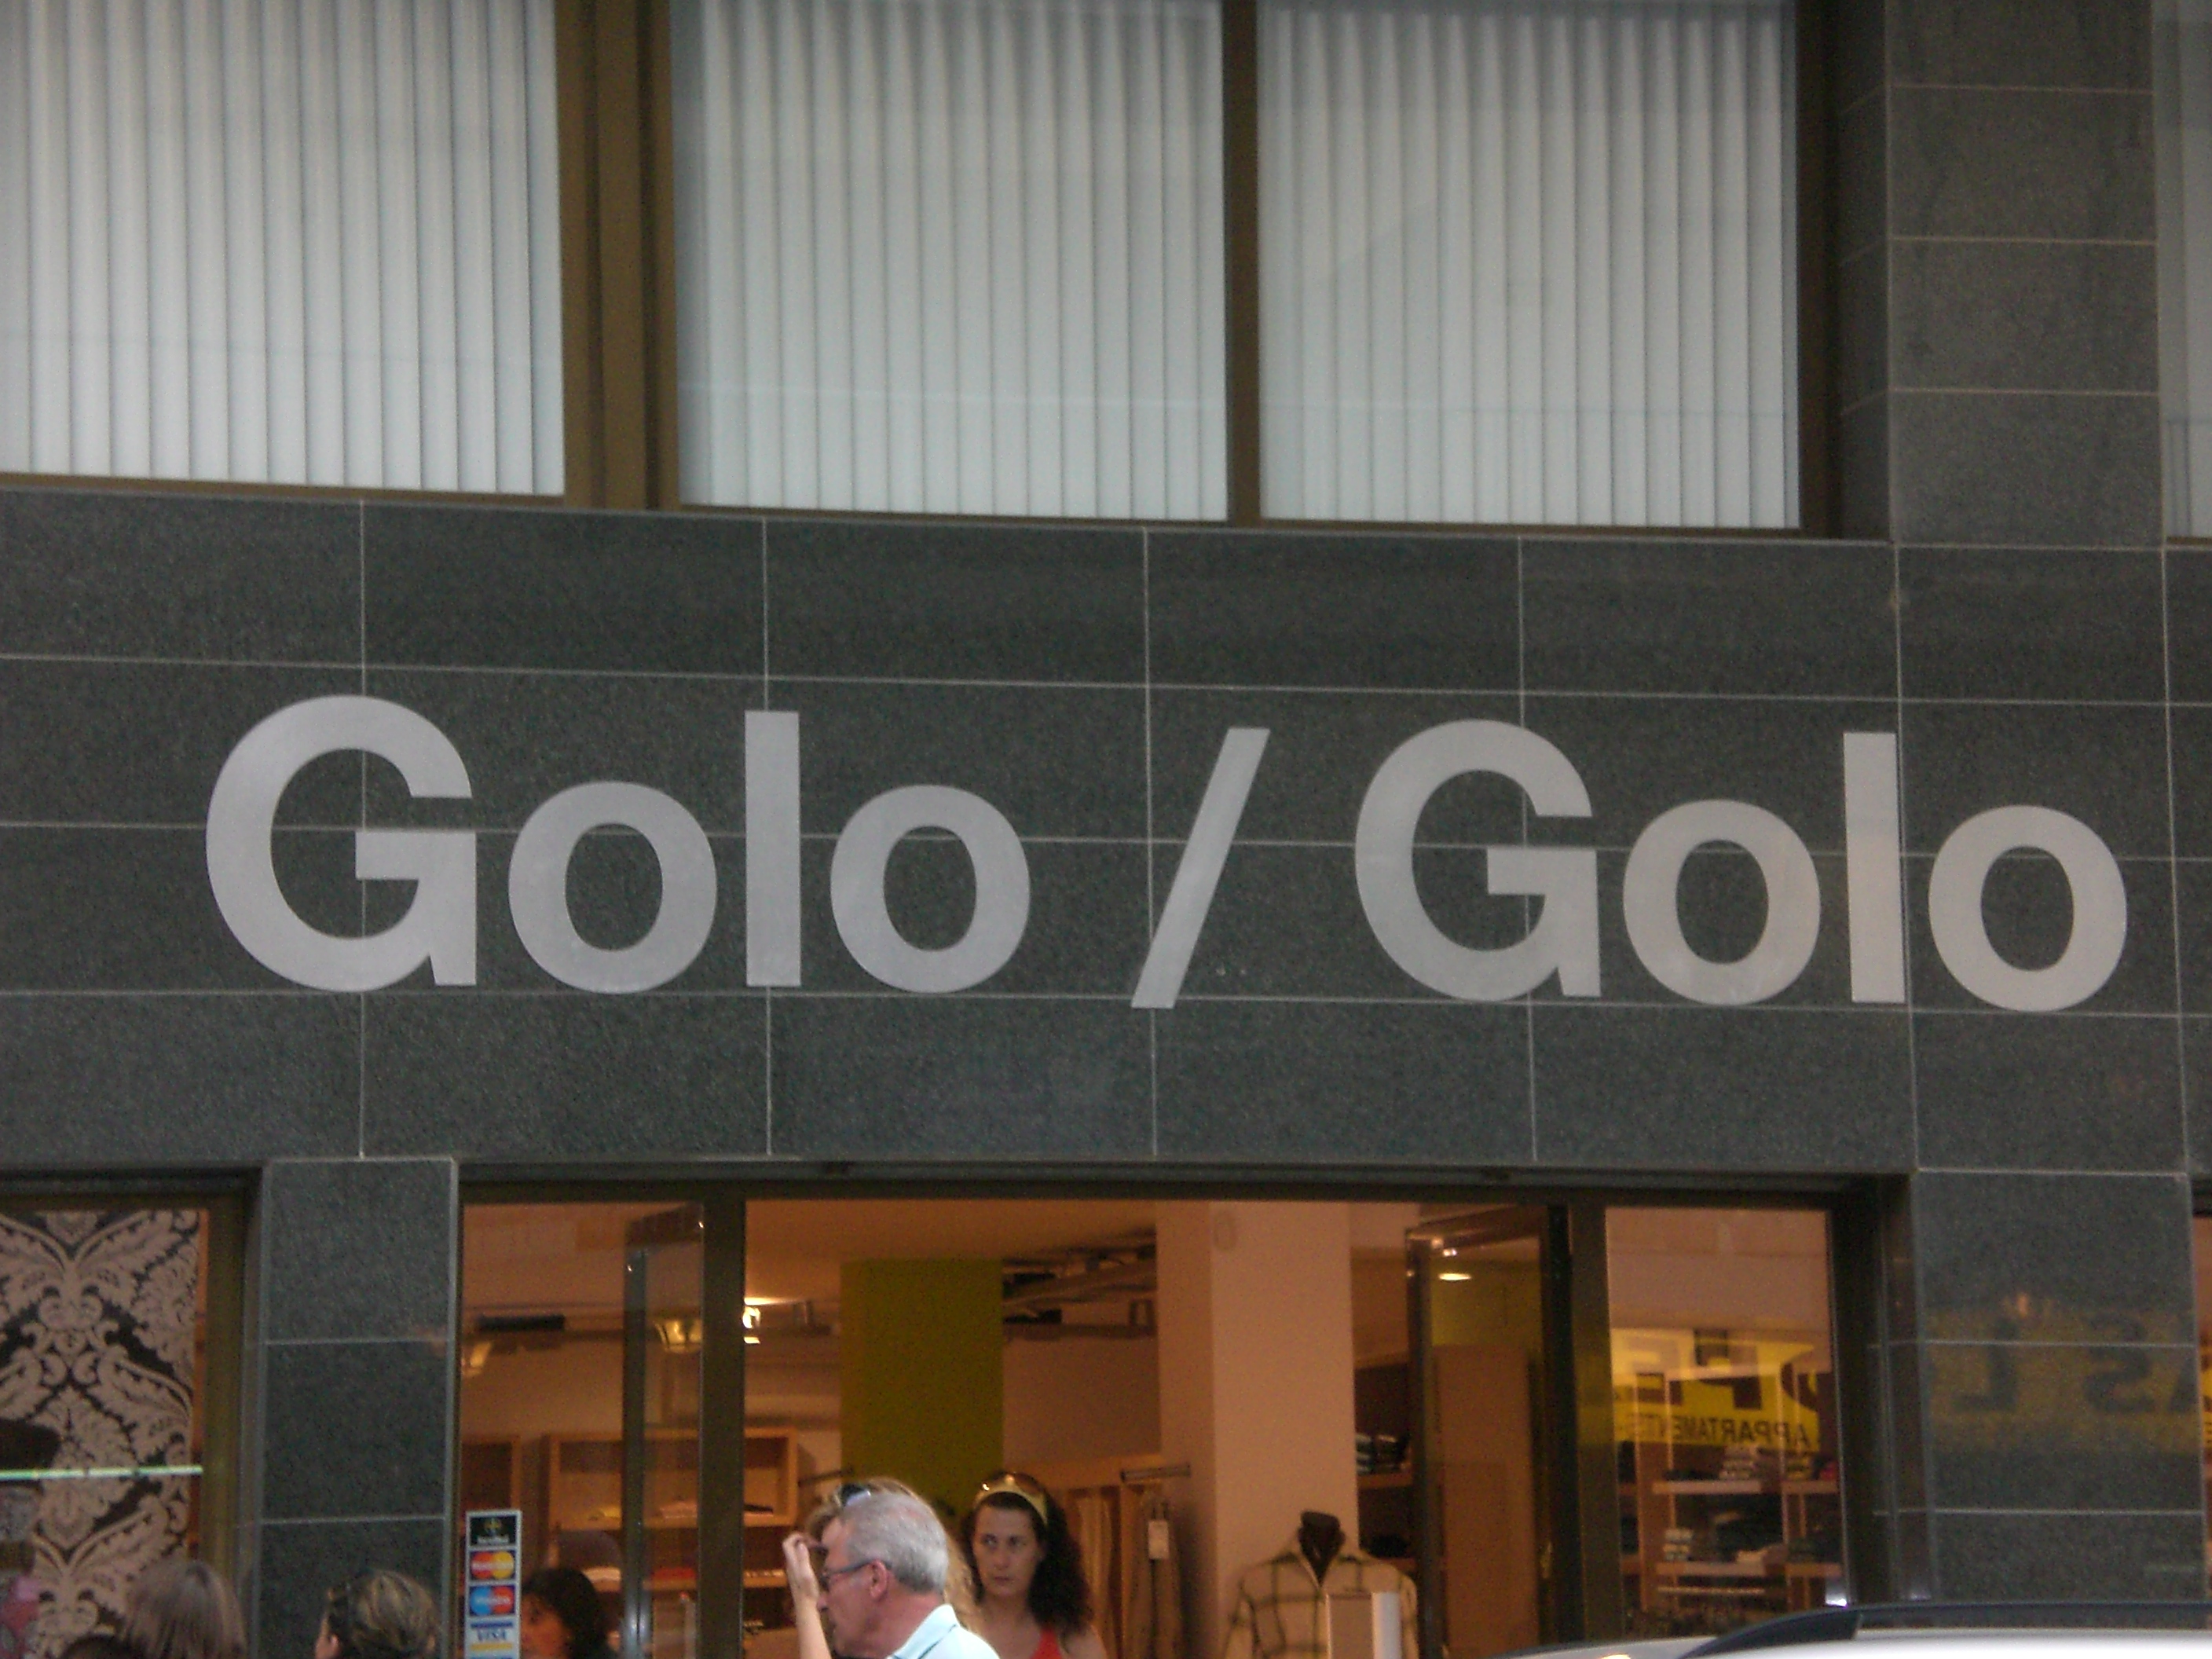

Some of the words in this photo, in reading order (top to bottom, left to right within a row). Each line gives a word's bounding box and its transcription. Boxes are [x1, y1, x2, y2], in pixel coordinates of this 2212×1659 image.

[205, 694, 1031, 995] Golo
[1130, 727, 1271, 1009] /
[1354, 718, 2128, 1013] Golo
[477, 1628, 507, 1641] VISA
